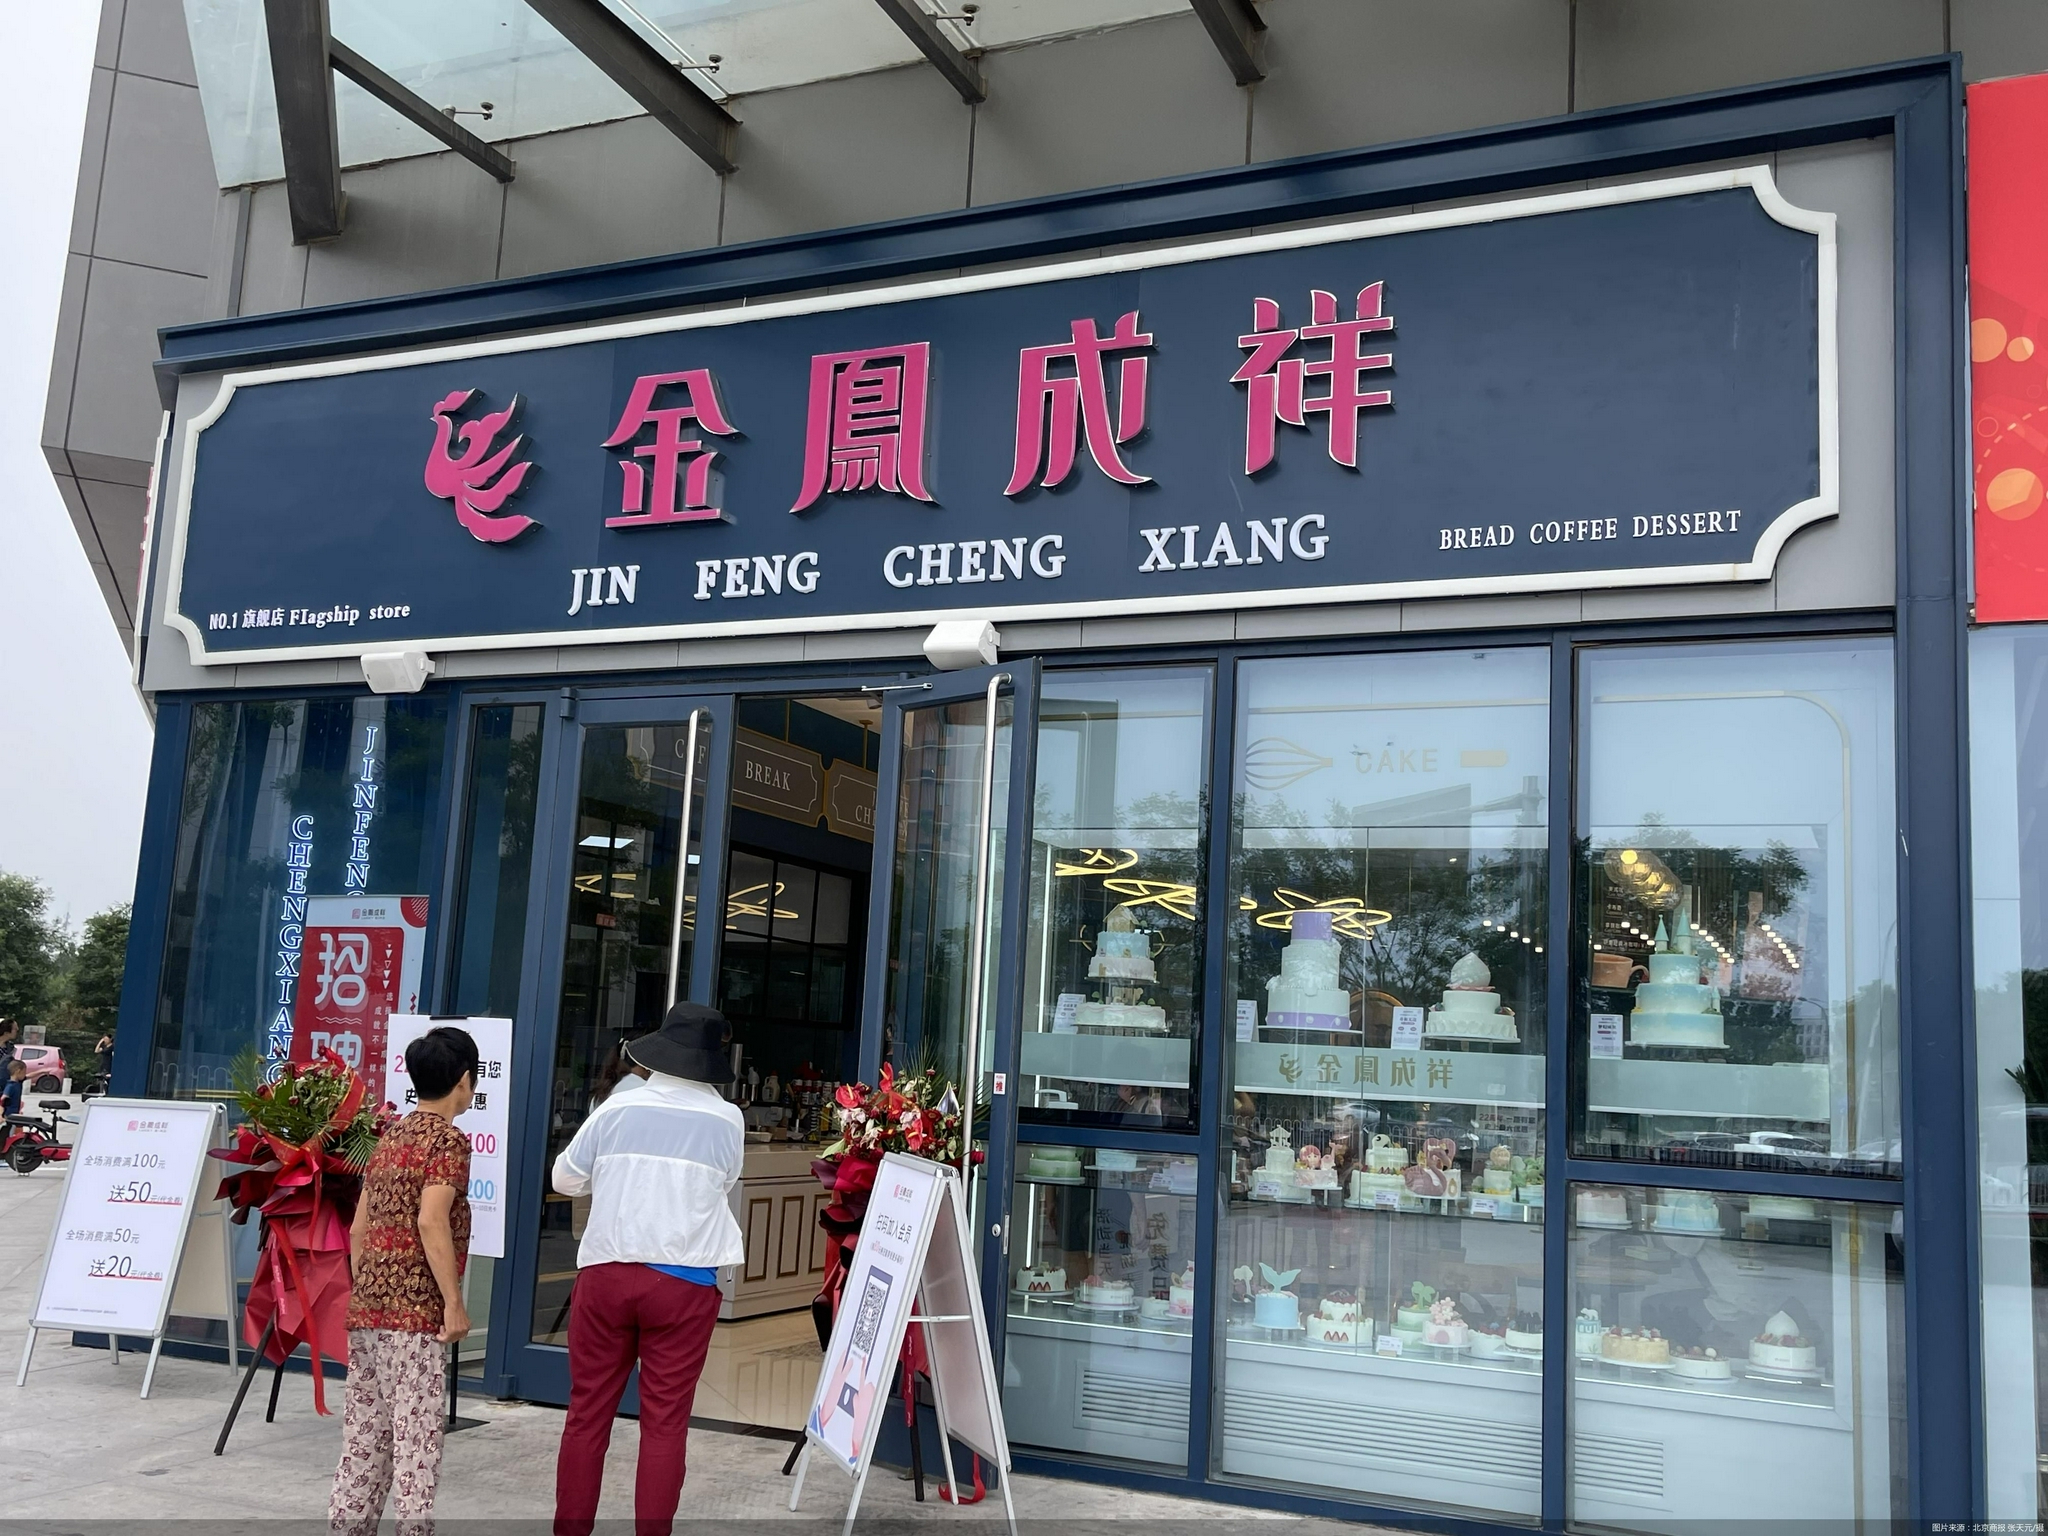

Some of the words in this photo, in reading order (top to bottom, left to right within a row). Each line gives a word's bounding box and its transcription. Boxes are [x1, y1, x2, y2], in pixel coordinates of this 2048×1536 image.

[1439, 525, 1515, 550] BREAD
[1530, 518, 1618, 544] COFFEE
[1632, 510, 1741, 538] DESSERT
[567, 565, 641, 616] JIN
[693, 552, 820, 600] FENG
[883, 535, 1066, 588] CHENG
[1138, 514, 1329, 573] XIANG
[209, 613, 237, 630] NO.1
[242, 609, 284, 628] 旗舰店
[369, 605, 410, 620] store
[745, 759, 791, 792] BREAK
[1354, 748, 1438, 774] CAKE
[345, 727, 377, 896] JINFEN
[84, 1153, 166, 1170] 全场消费满100元
[65, 1228, 140, 1244] 全场消费满50元
[875, 1212, 913, 1244] 扫码加入会员
